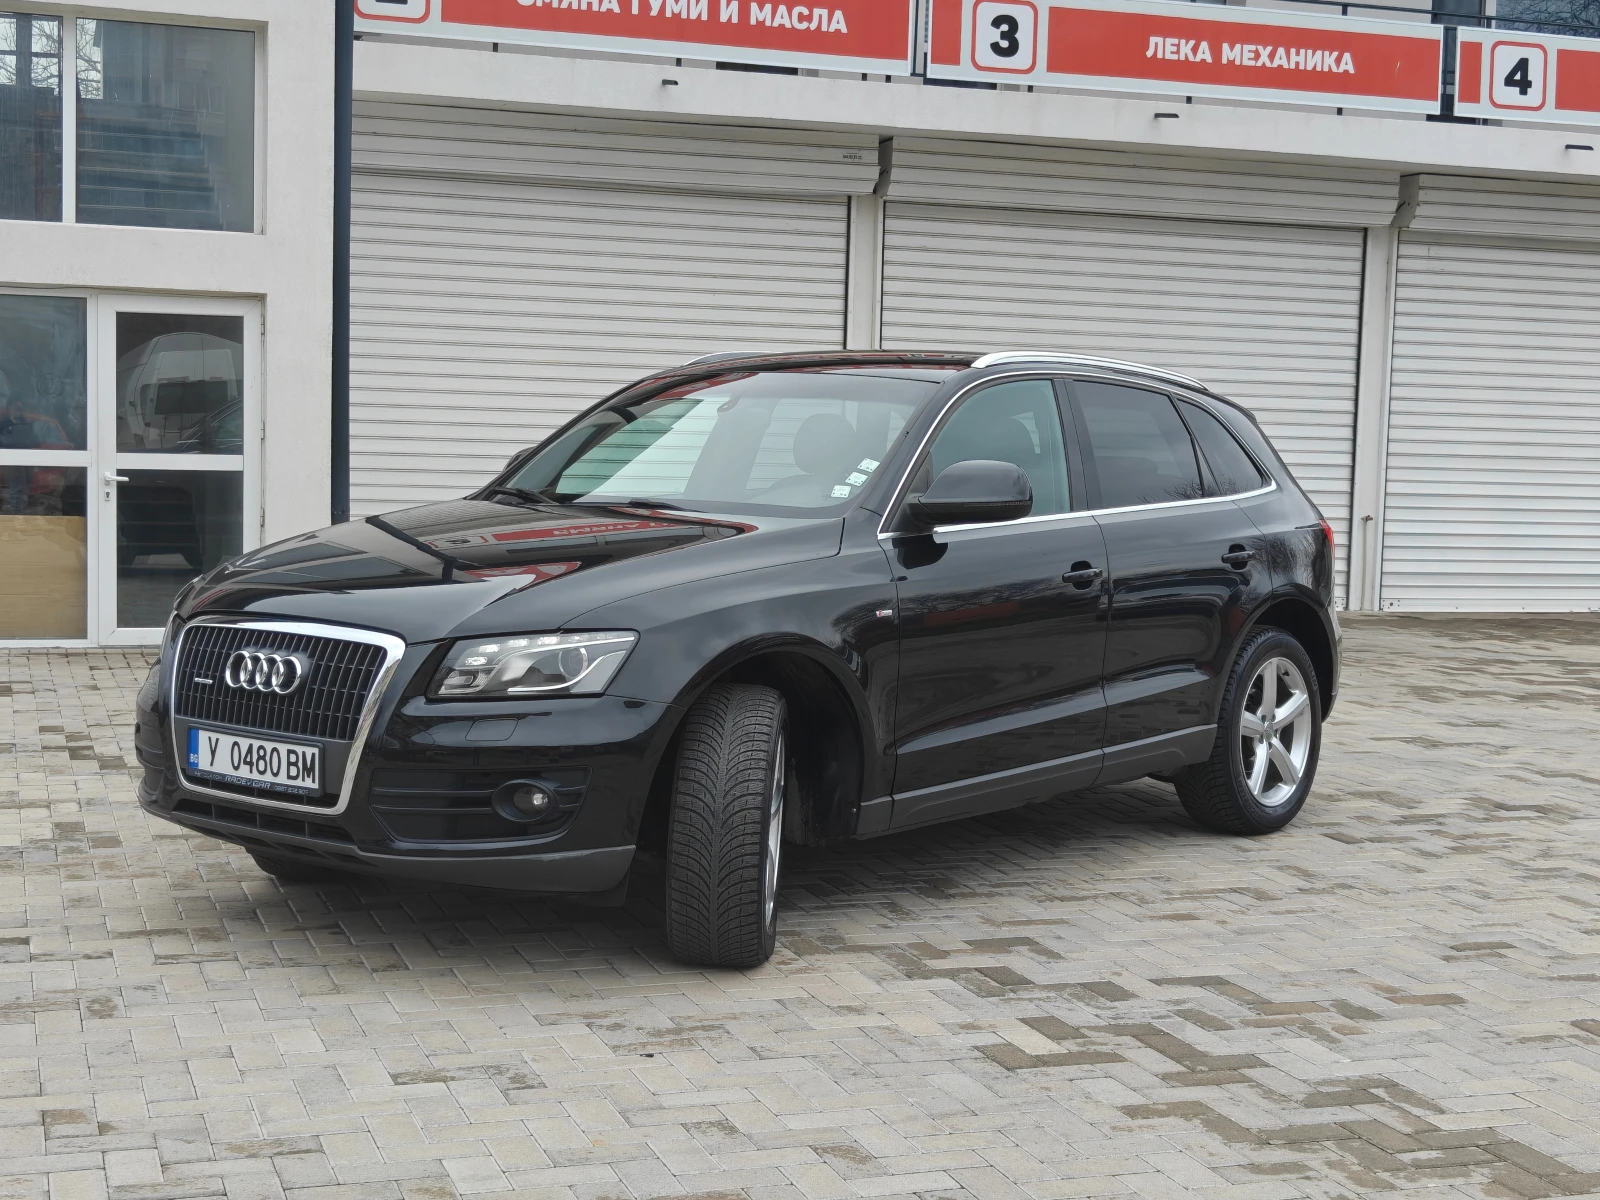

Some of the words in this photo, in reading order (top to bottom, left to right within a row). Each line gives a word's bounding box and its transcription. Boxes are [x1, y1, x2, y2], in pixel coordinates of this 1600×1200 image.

[719, 0, 739, 24] И
[750, 2, 848, 34] МАСЛА
[989, 14, 1020, 58] 3
[1145, 36, 1213, 64] ЛЕКА
[1221, 43, 1355, 74] МЕХАНИКА
[1503, 57, 1533, 96] 4
[190, 753, 199, 764] BG
[230, 740, 281, 777] 0480
[286, 748, 316, 783] BM
